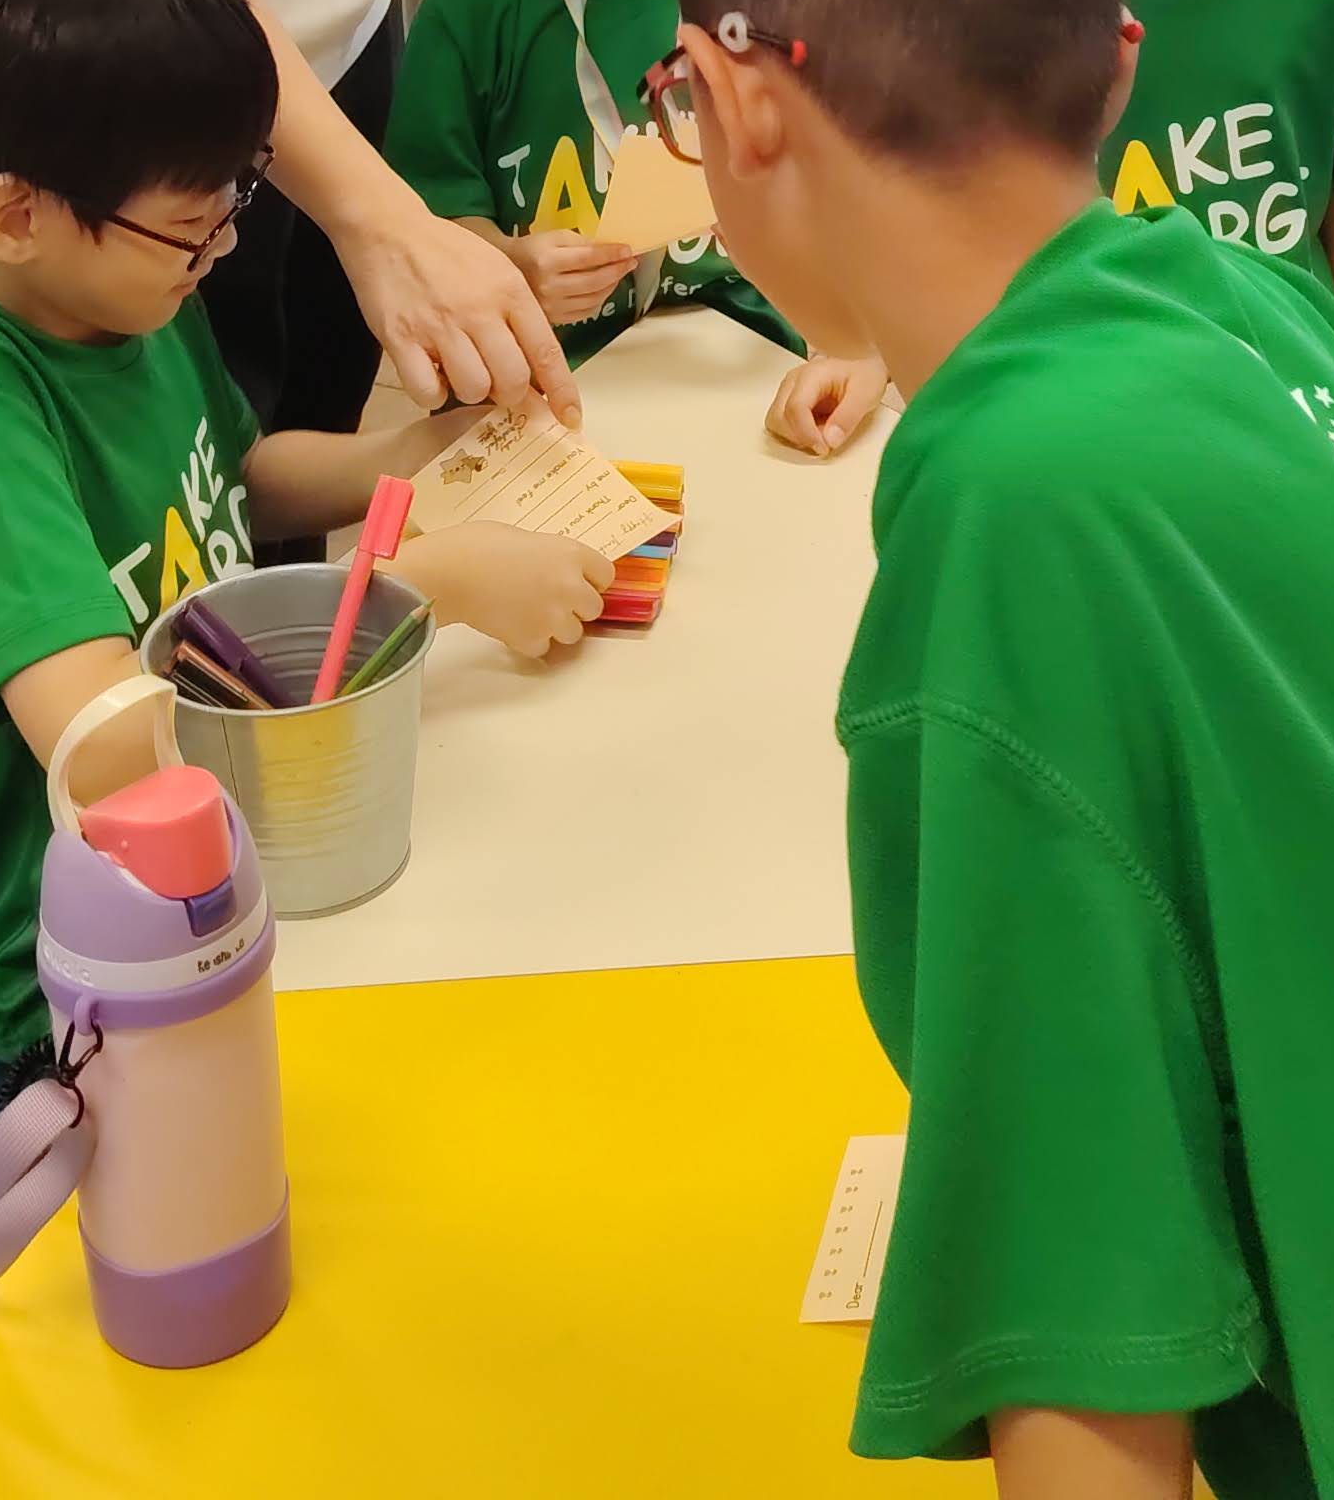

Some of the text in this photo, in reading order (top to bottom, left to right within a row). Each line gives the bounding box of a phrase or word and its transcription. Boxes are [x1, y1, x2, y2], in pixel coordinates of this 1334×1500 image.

[566, 447, 585, 460] You
[547, 459, 568, 476] make
[585, 470, 611, 492] me by
[617, 495, 637, 512] Dear
[557, 495, 612, 536] Thank you fo
[846, 1282, 864, 1310] Dear
